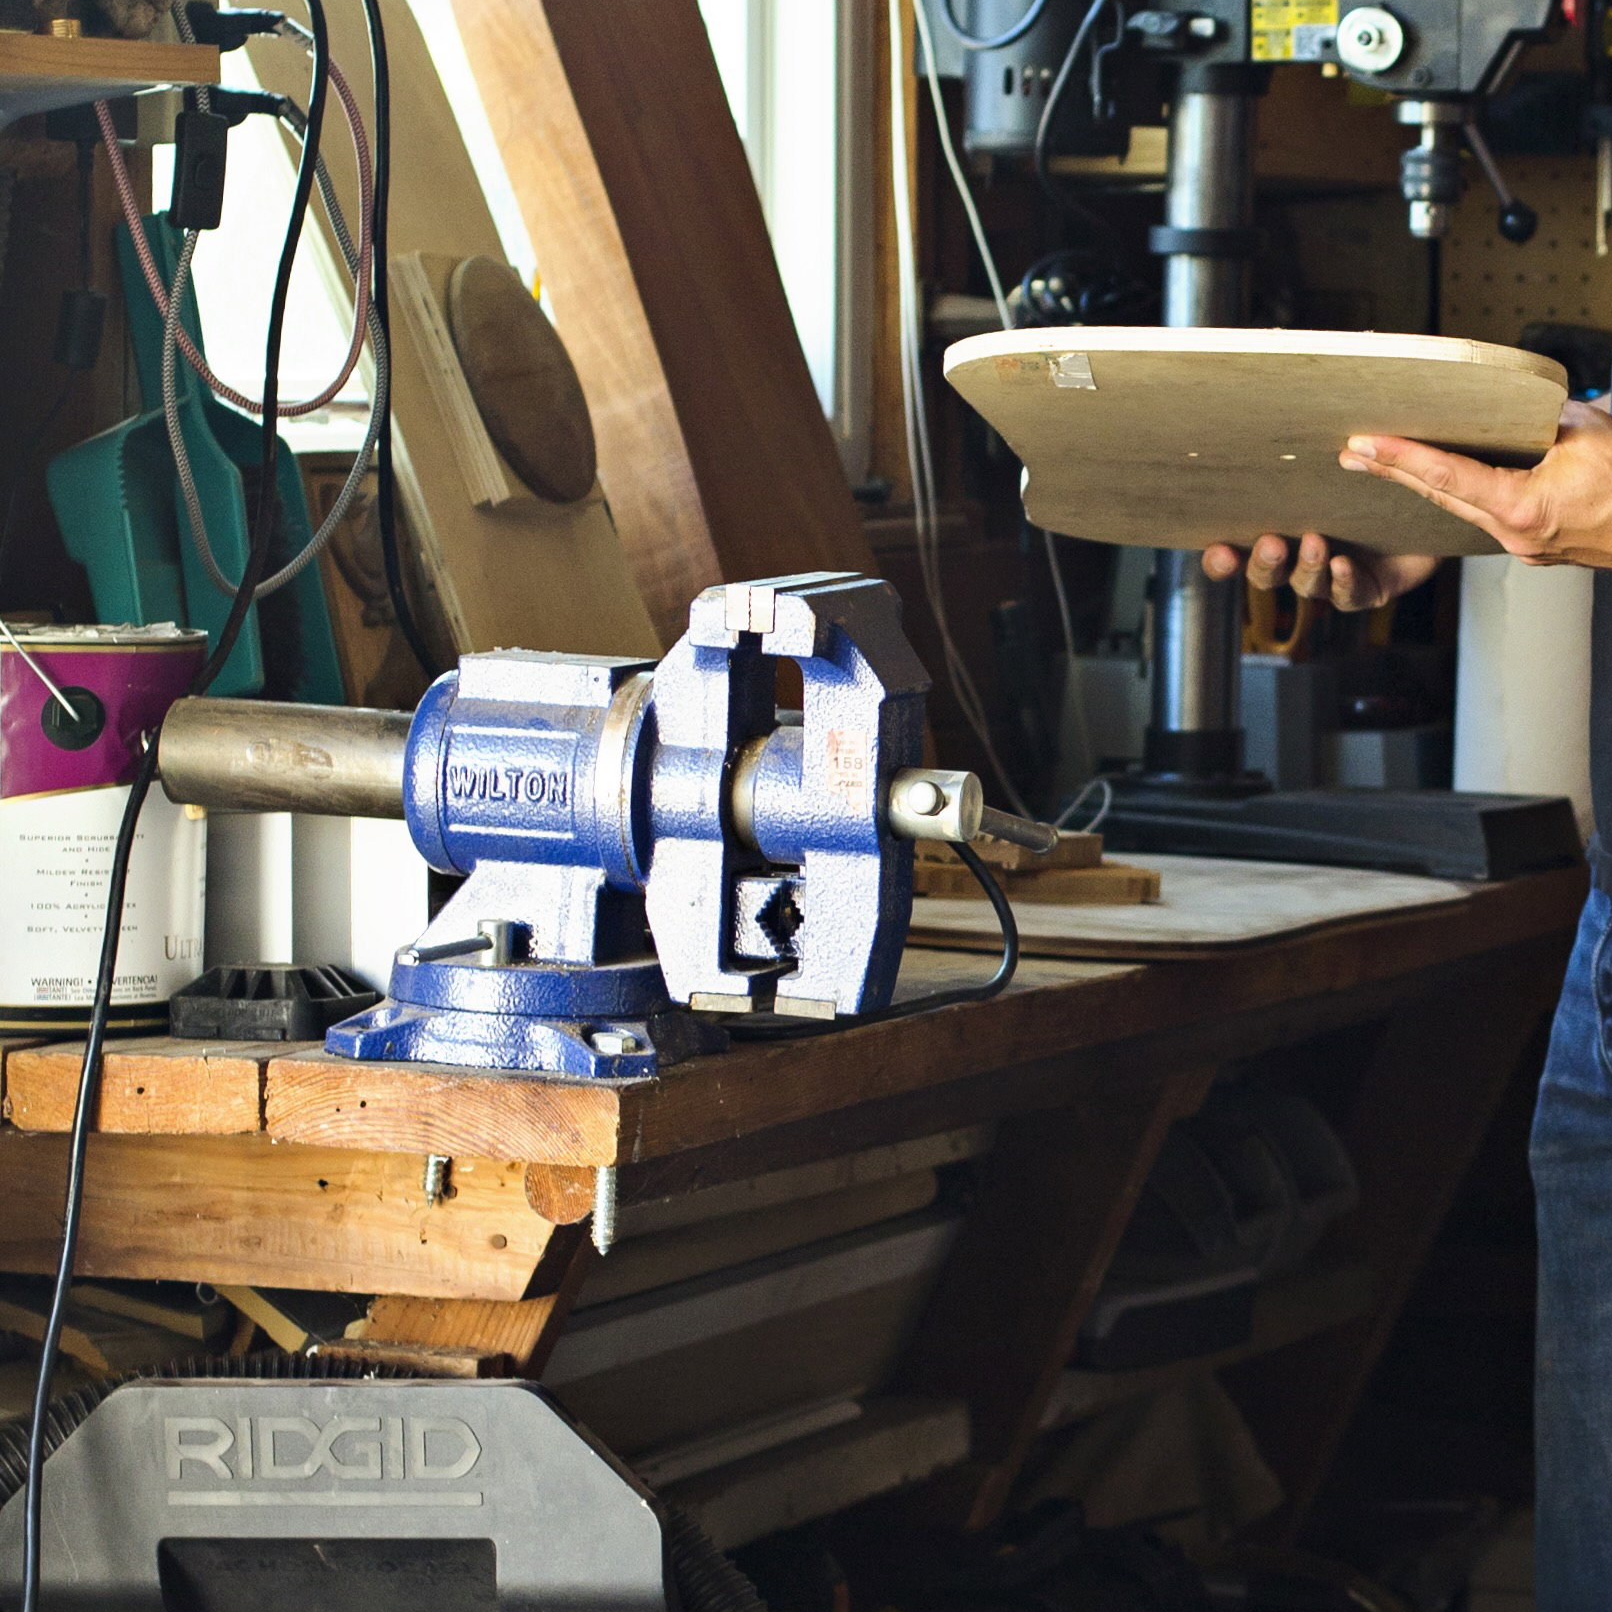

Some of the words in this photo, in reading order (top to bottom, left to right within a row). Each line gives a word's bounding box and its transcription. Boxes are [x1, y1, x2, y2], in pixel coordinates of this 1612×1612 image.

[834, 756, 863, 770] 158
[450, 765, 567, 805] WILTON
[31, 978, 84, 987] WARNING!
[165, 1416, 483, 1480] RIDGID
